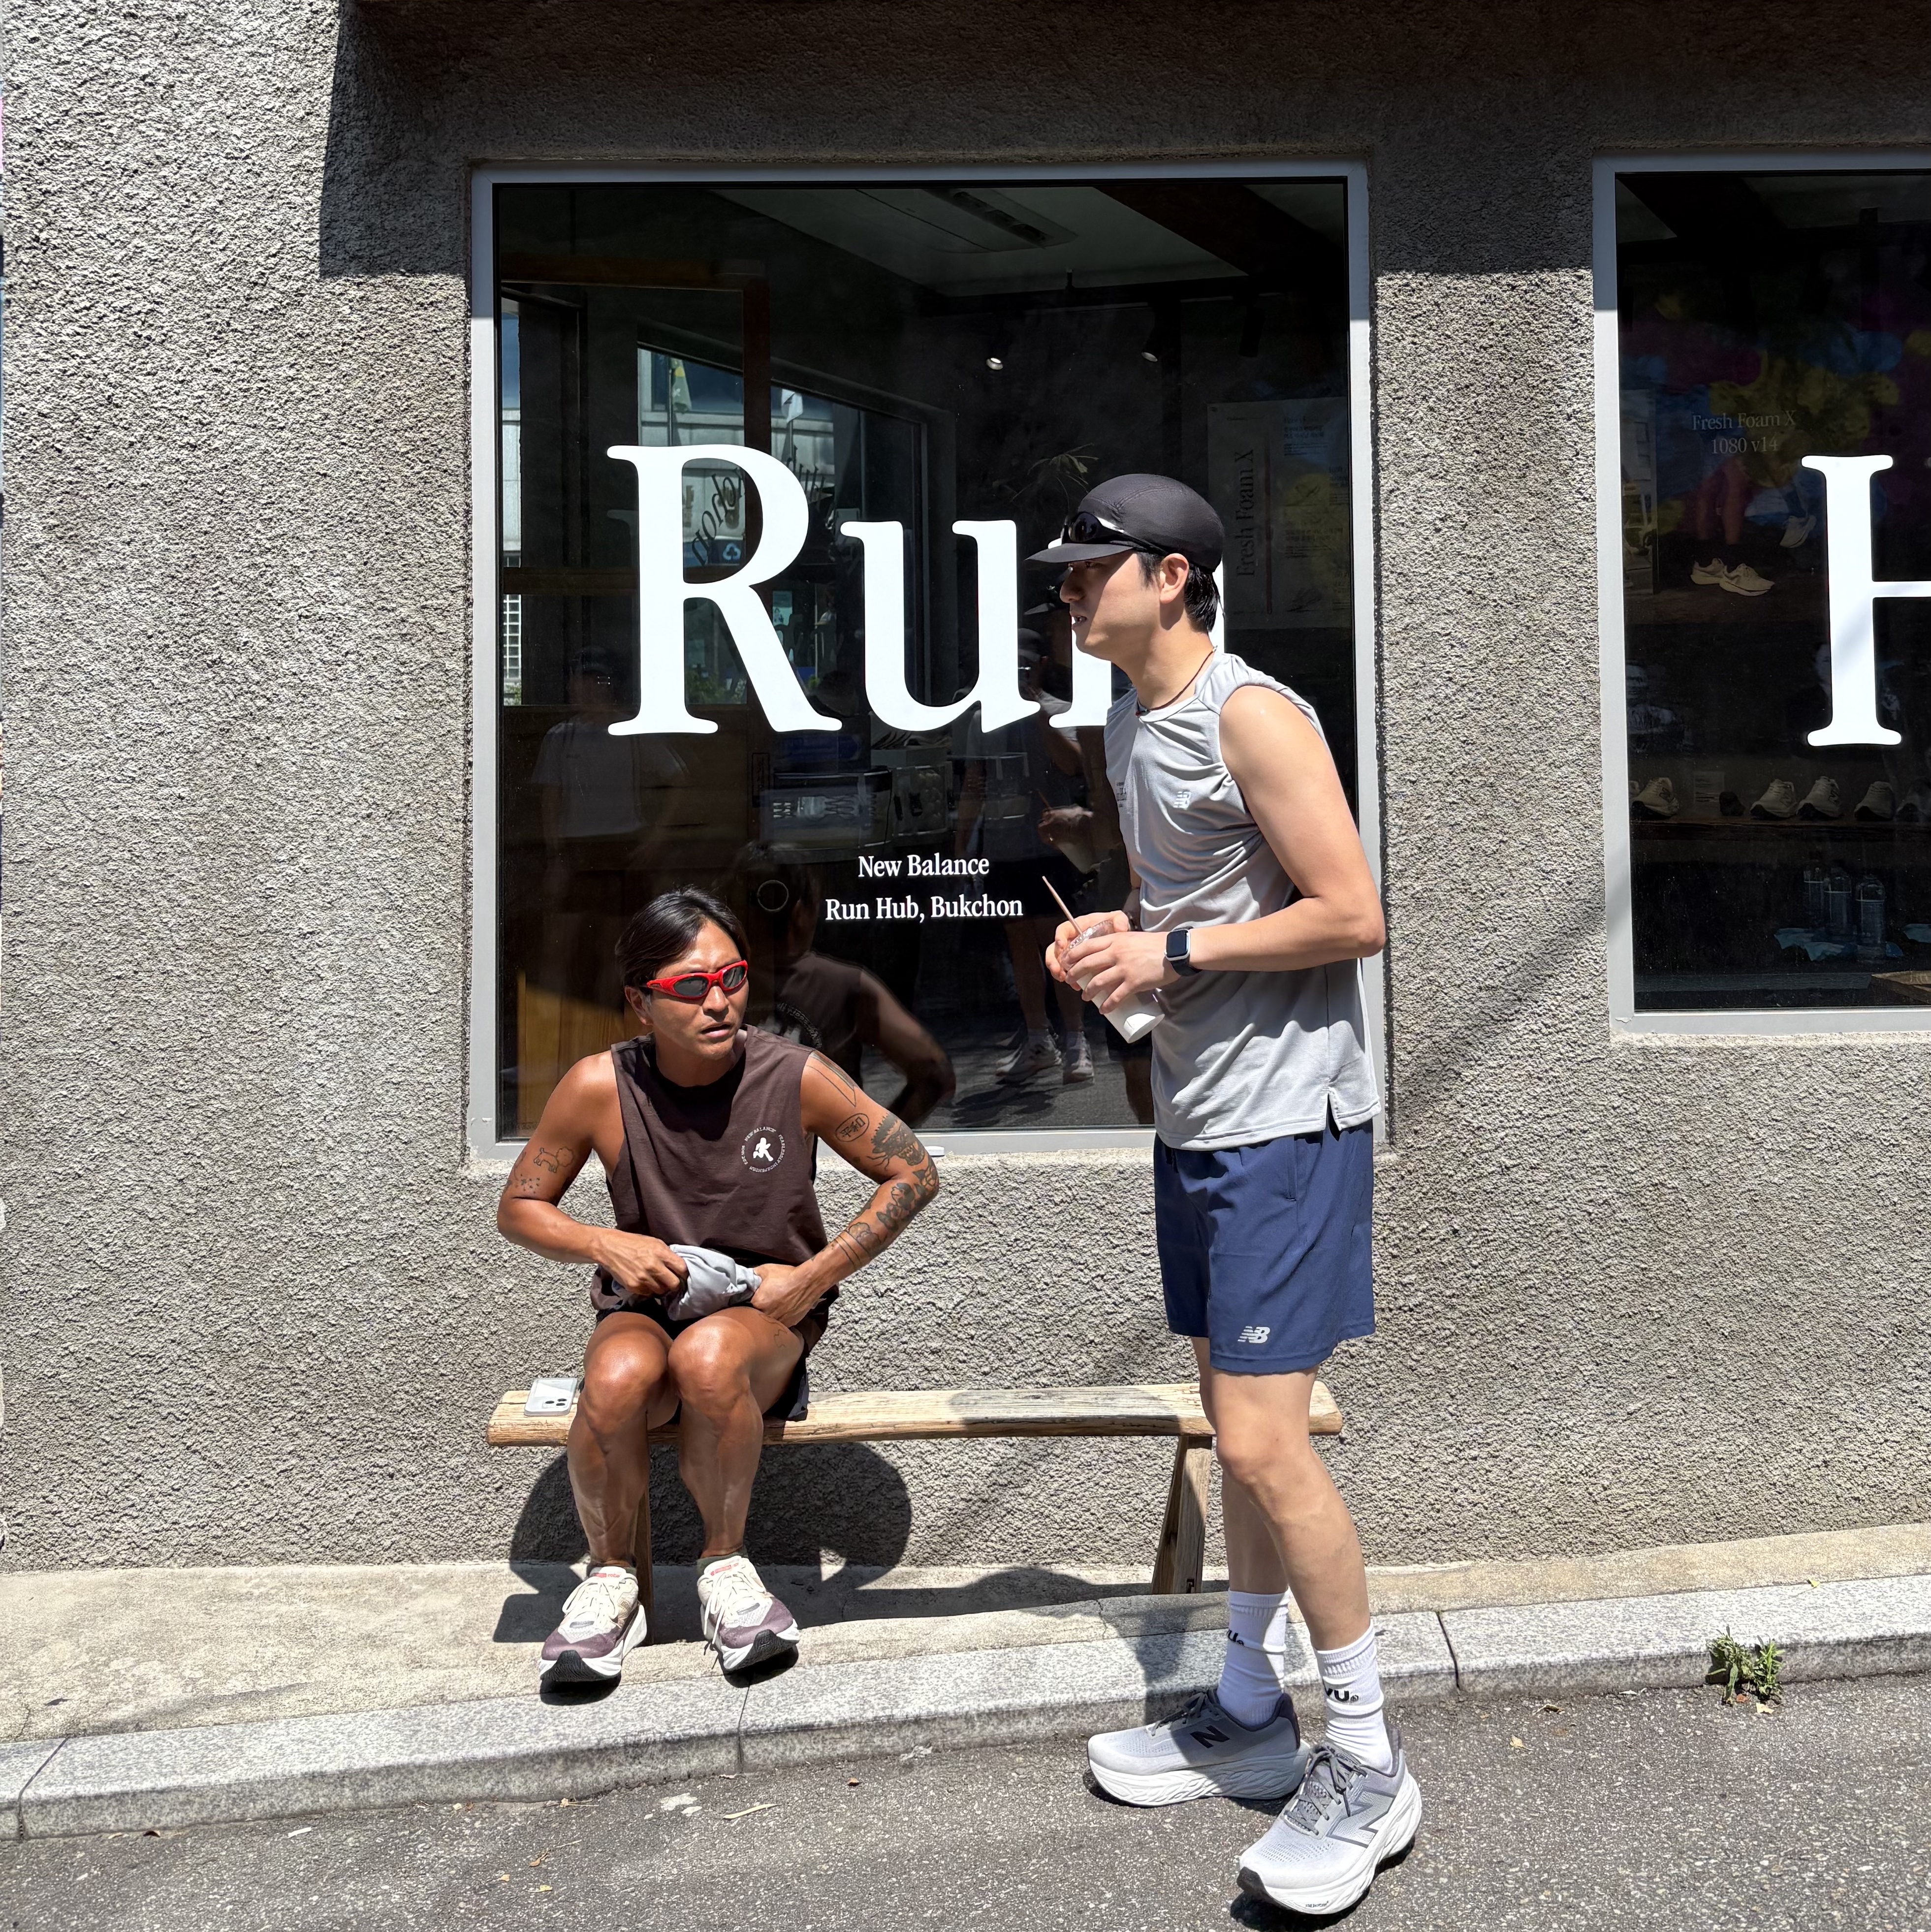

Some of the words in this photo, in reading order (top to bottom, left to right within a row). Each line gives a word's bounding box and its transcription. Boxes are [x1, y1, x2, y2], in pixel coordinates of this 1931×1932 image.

[1692, 412, 1732, 430] Fresh
[1738, 413, 1780, 428] Foam
[1785, 410, 1796, 425] X
[1711, 437, 1747, 454] 1080
[1751, 431, 1779, 452] v14
[1235, 449, 1254, 463] X
[1235, 469, 1254, 520] Foam
[1235, 528, 1255, 576] Fresh
[858, 856, 902, 878] New
[907, 852, 989, 876] Balance
[825, 899, 870, 920] Run
[876, 895, 925, 923] Hub,
[931, 893, 1024, 918] Bukchon
[1237, 1326, 1270, 1344] NB
